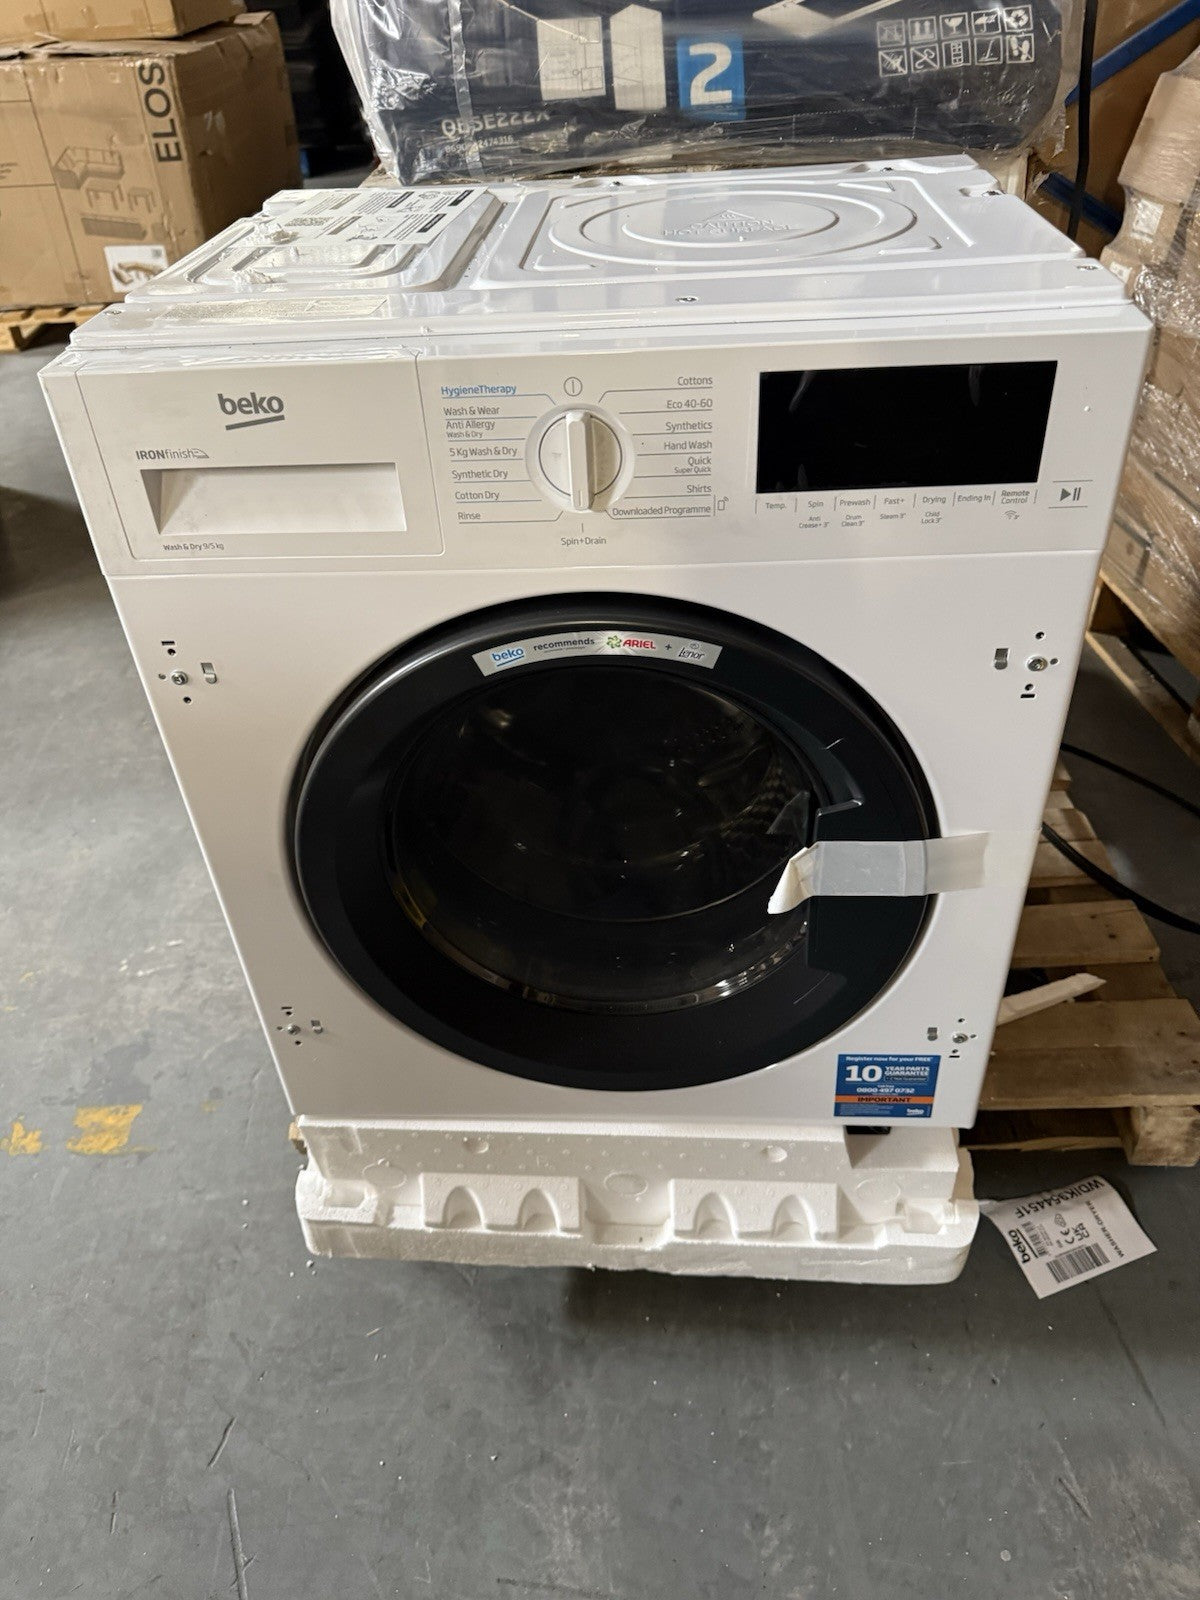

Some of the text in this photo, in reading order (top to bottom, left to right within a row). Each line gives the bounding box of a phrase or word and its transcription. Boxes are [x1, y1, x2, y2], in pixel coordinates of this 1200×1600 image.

[690, 42, 734, 106] 2
[138, 63, 183, 162] ELOS
[677, 376, 713, 386] Cottons
[440, 384, 517, 397] HygieneTherapy
[217, 392, 285, 416] beko
[666, 398, 713, 409] Eco 40-60
[443, 405, 500, 416] Wash & Wear
[446, 420, 496, 431] Anti Allergy
[665, 420, 713, 433] Synthetics
[471, 430, 483, 439] Dry
[664, 439, 713, 450] Hand Wash
[135, 448, 195, 460] IRONfinish
[449, 446, 518, 458] 5 Kg Wash & Dry
[687, 456, 712, 466] Quick
[451, 469, 509, 481] Synthetic Dry
[674, 466, 712, 474] Super Quick
[686, 484, 712, 493] Shirts
[1001, 489, 1030, 497] Remote
[454, 490, 500, 501] Cotton Dry
[884, 497, 904, 505] Fast+
[922, 495, 947, 504] Drying
[957, 494, 992, 503] Ending In
[1001, 496, 1028, 505] Control
[765, 502, 787, 510] Temp.
[807, 500, 824, 509] Spin
[839, 498, 871, 507] Prewash
[457, 511, 481, 520] Rinse
[612, 505, 711, 516] Downloaded Programme
[163, 543, 183, 551] Wash
[183, 543, 189, 551] &
[189, 543, 202, 551] Dry
[216, 542, 225, 551] kg
[491, 648, 525, 662] beko
[533, 637, 596, 651] recommends
[622, 638, 657, 650] ARIEL
[845, 1064, 883, 1083] 10
[1008, 1229, 1032, 1264] beko
